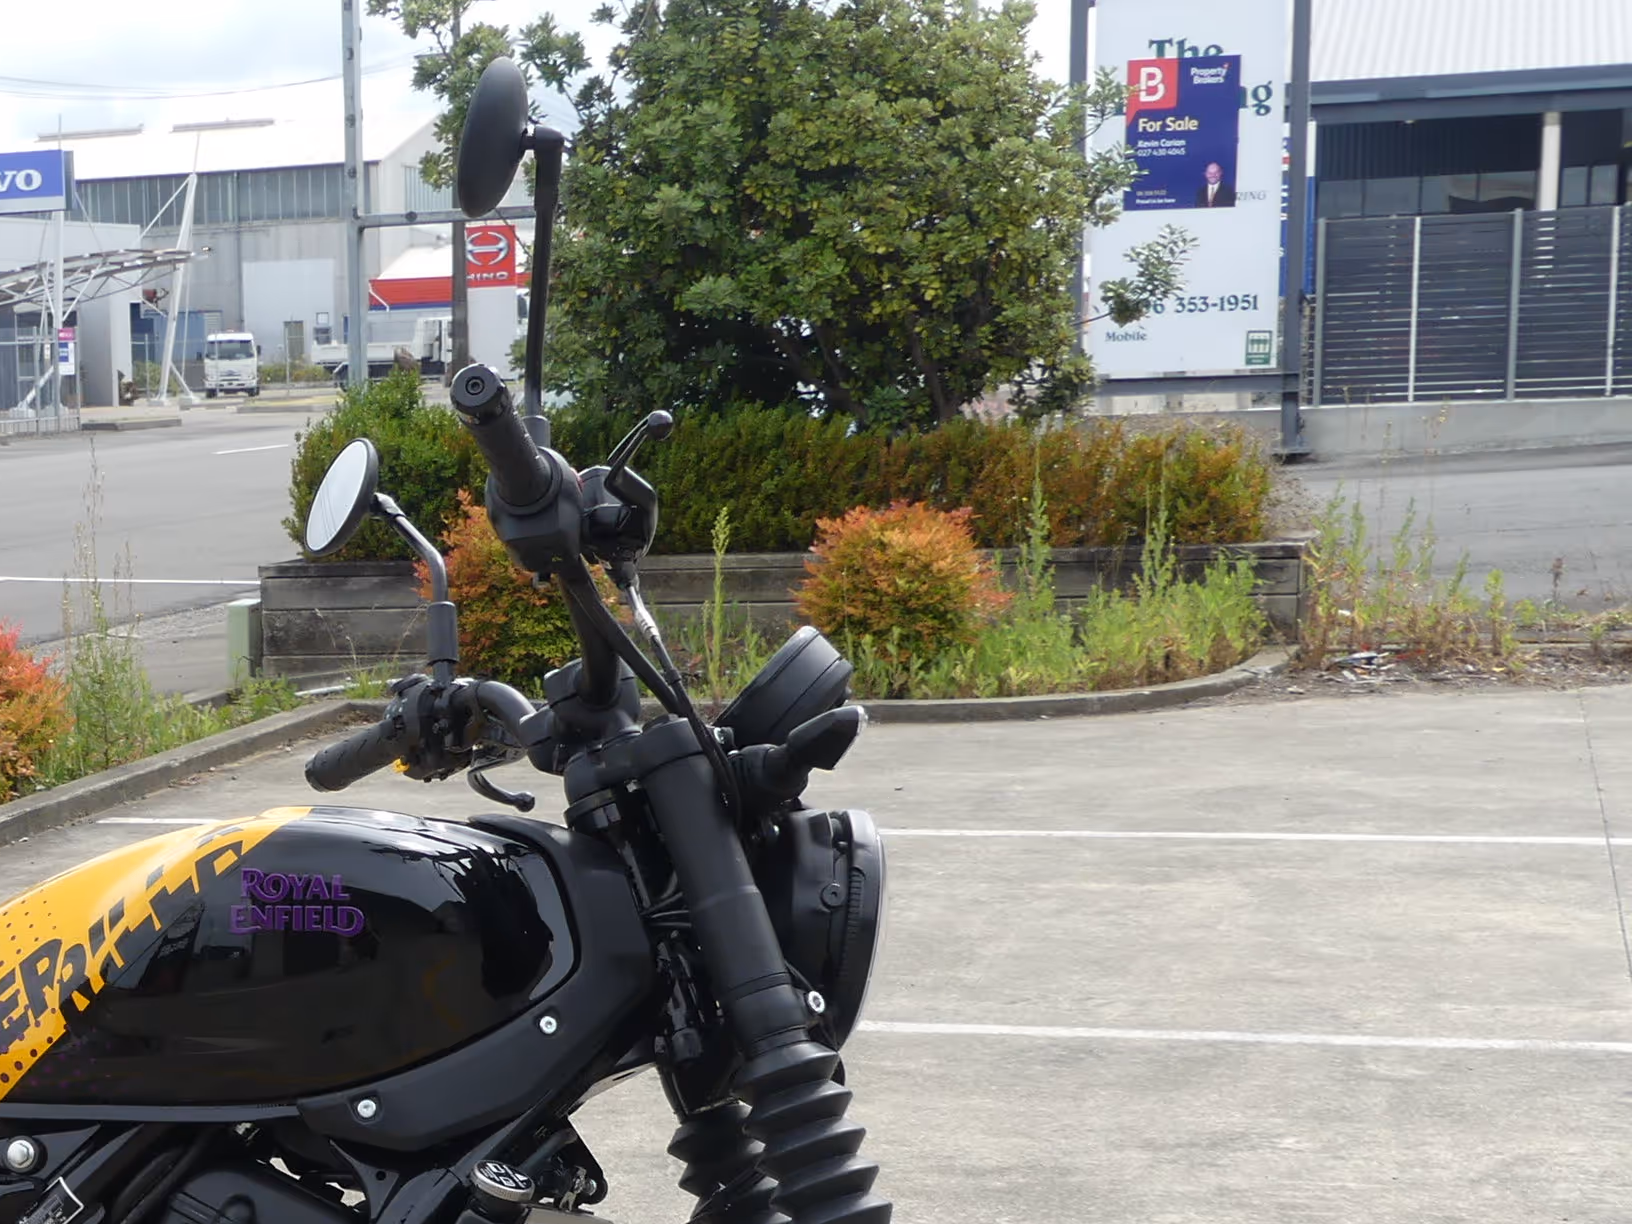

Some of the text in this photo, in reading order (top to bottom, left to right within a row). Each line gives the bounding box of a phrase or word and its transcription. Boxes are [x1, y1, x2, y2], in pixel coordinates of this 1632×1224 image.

[1190, 65, 1227, 77] Property
[1139, 66, 1165, 102] B
[1138, 115, 1199, 132] For Sale
[1174, 294, 1259, 313] 353-1951
[1105, 331, 1147, 342] Mobile
[240, 867, 351, 903] ROYAL
[229, 904, 366, 937] ENFIELD
